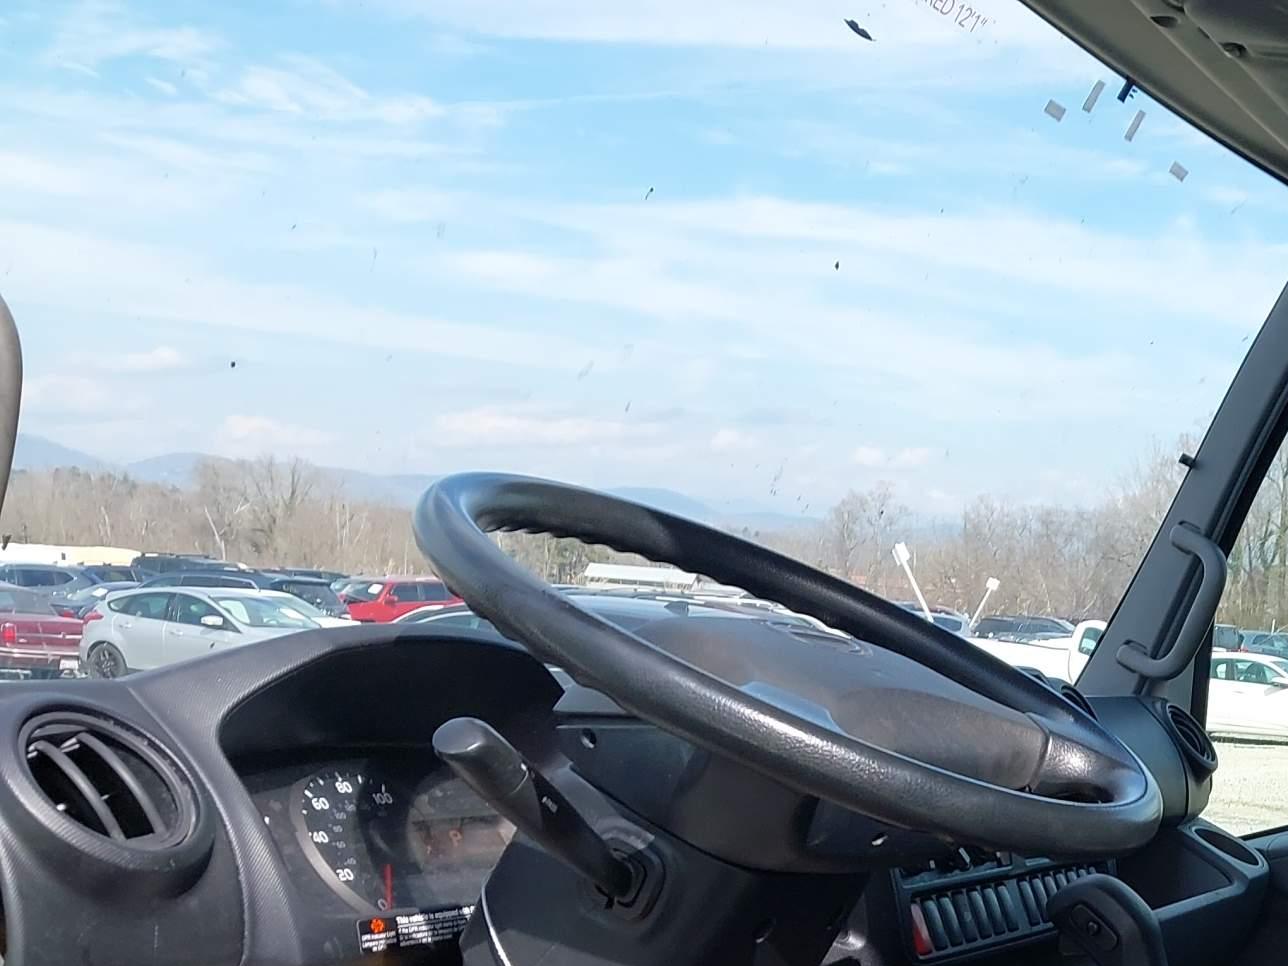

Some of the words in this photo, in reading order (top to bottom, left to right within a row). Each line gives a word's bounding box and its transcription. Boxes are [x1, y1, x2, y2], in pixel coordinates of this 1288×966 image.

[335, 781, 353, 793] 80
[311, 797, 329, 810] 60
[372, 793, 393, 804] 100
[312, 830, 329, 843] 40
[336, 868, 354, 881] 20
